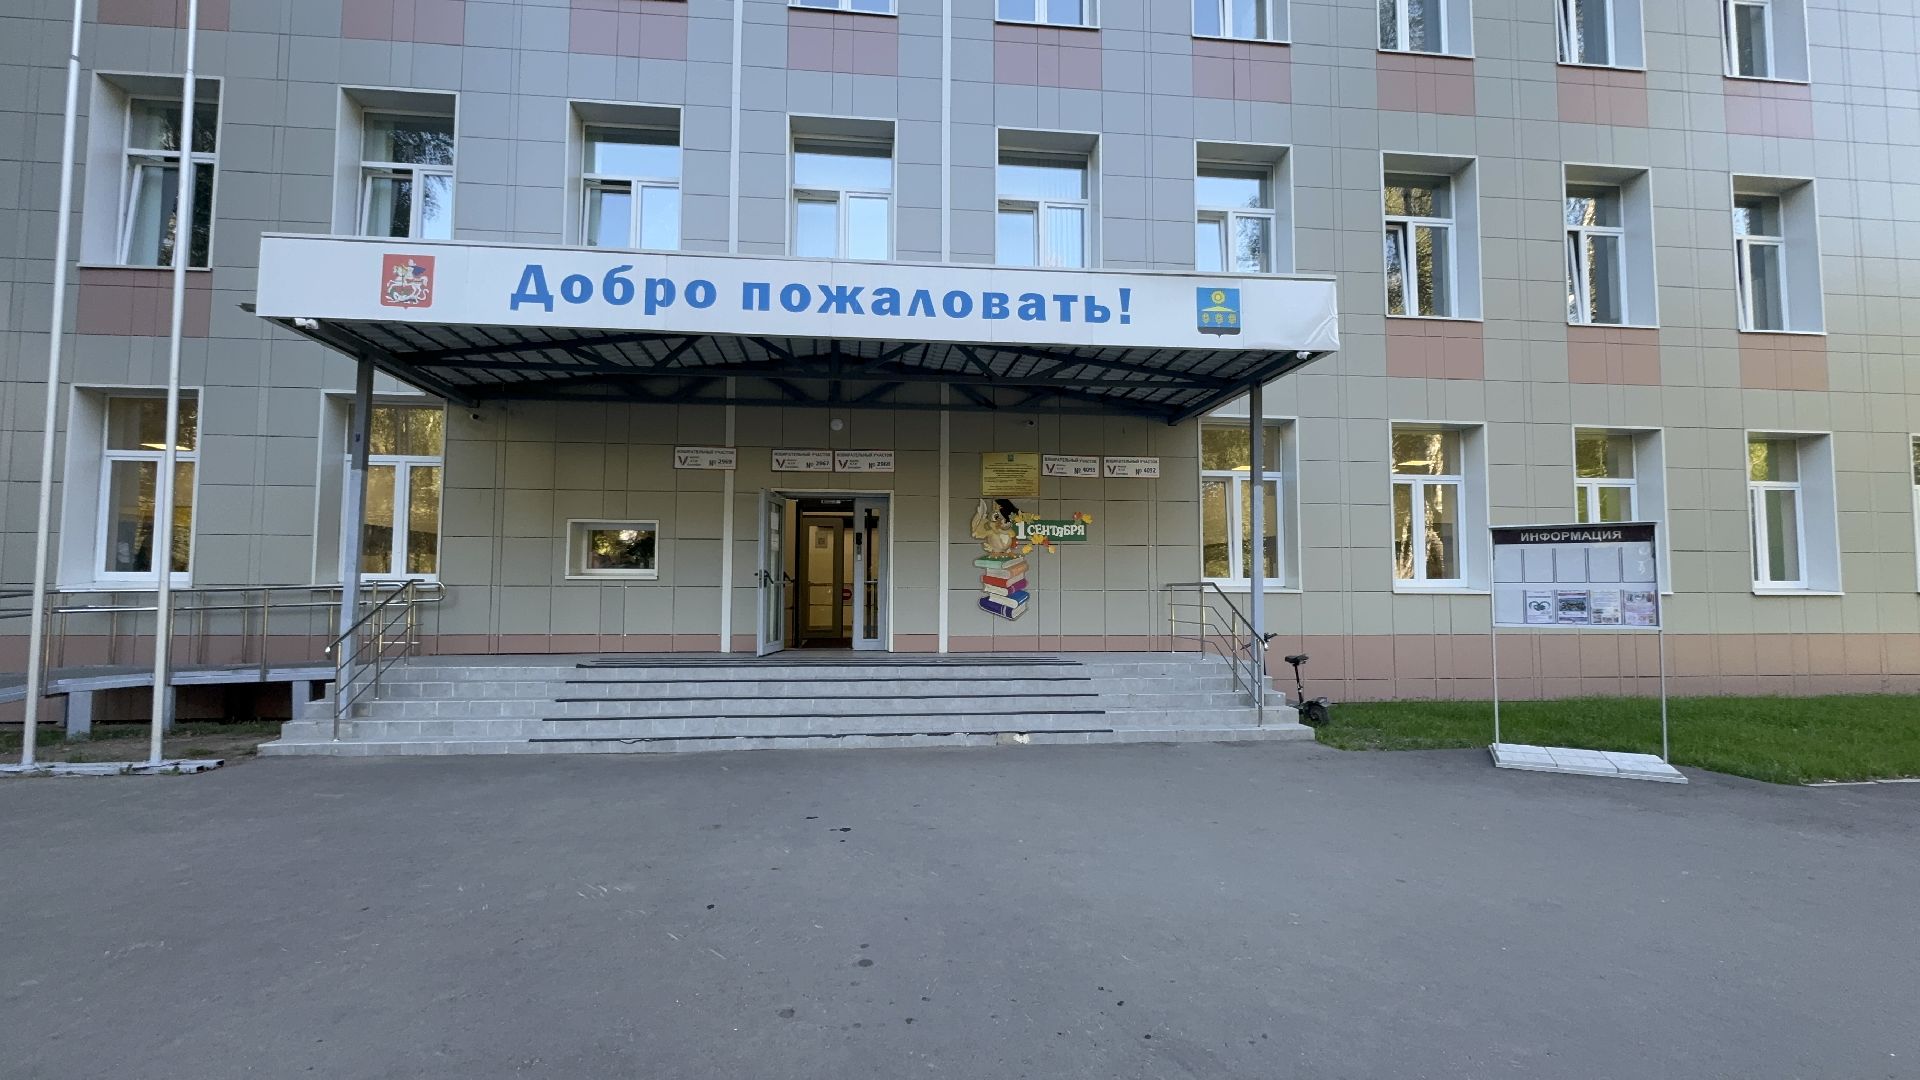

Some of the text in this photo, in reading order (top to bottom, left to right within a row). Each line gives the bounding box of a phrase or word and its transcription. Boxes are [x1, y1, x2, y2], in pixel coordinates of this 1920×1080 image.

[510, 264, 1131, 325] Добро пожаловать!
[1015, 521, 1085, 540] 1 СЕНТЯБРЯ
[1520, 530, 1622, 541] ИНФОРМАЦИЯ
